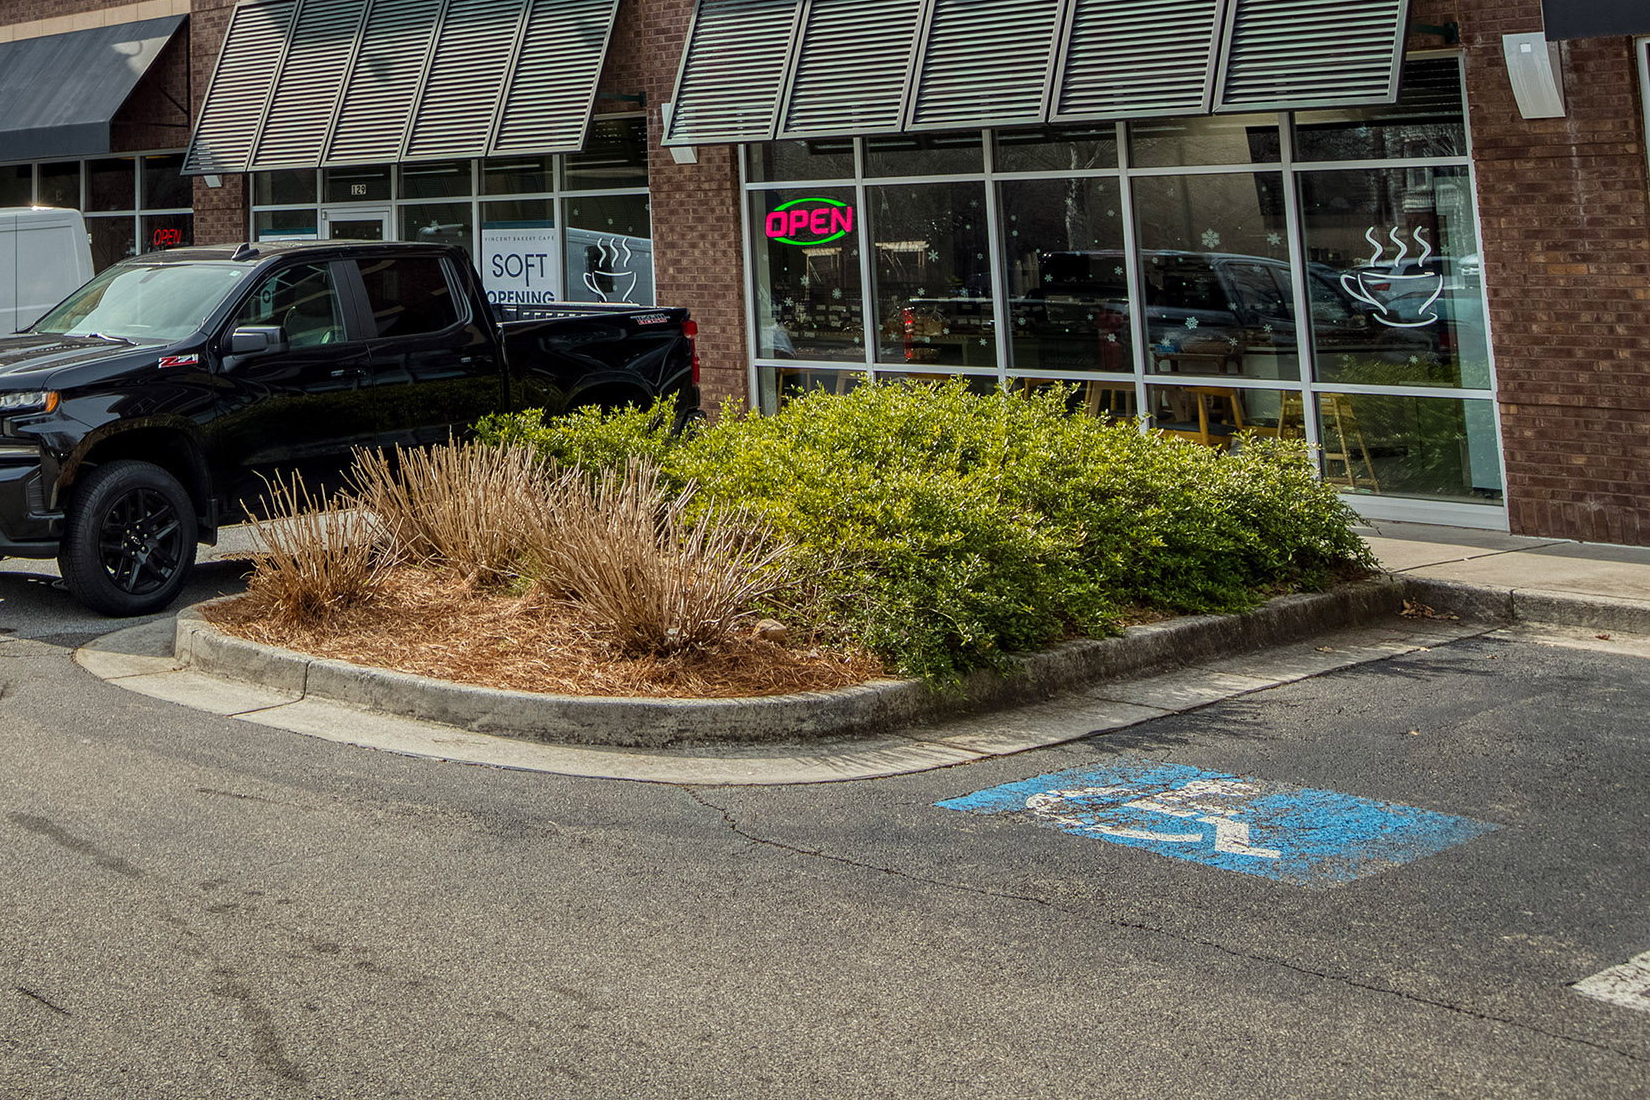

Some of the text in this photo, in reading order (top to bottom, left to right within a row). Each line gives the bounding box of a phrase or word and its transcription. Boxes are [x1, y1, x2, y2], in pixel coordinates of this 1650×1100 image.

[351, 184, 366, 195] 129
[765, 206, 853, 238] OPEN
[153, 228, 182, 245] OPEN
[492, 253, 548, 287] SOFT
[487, 290, 556, 304] OPENING
[158, 353, 199, 369] Z71
